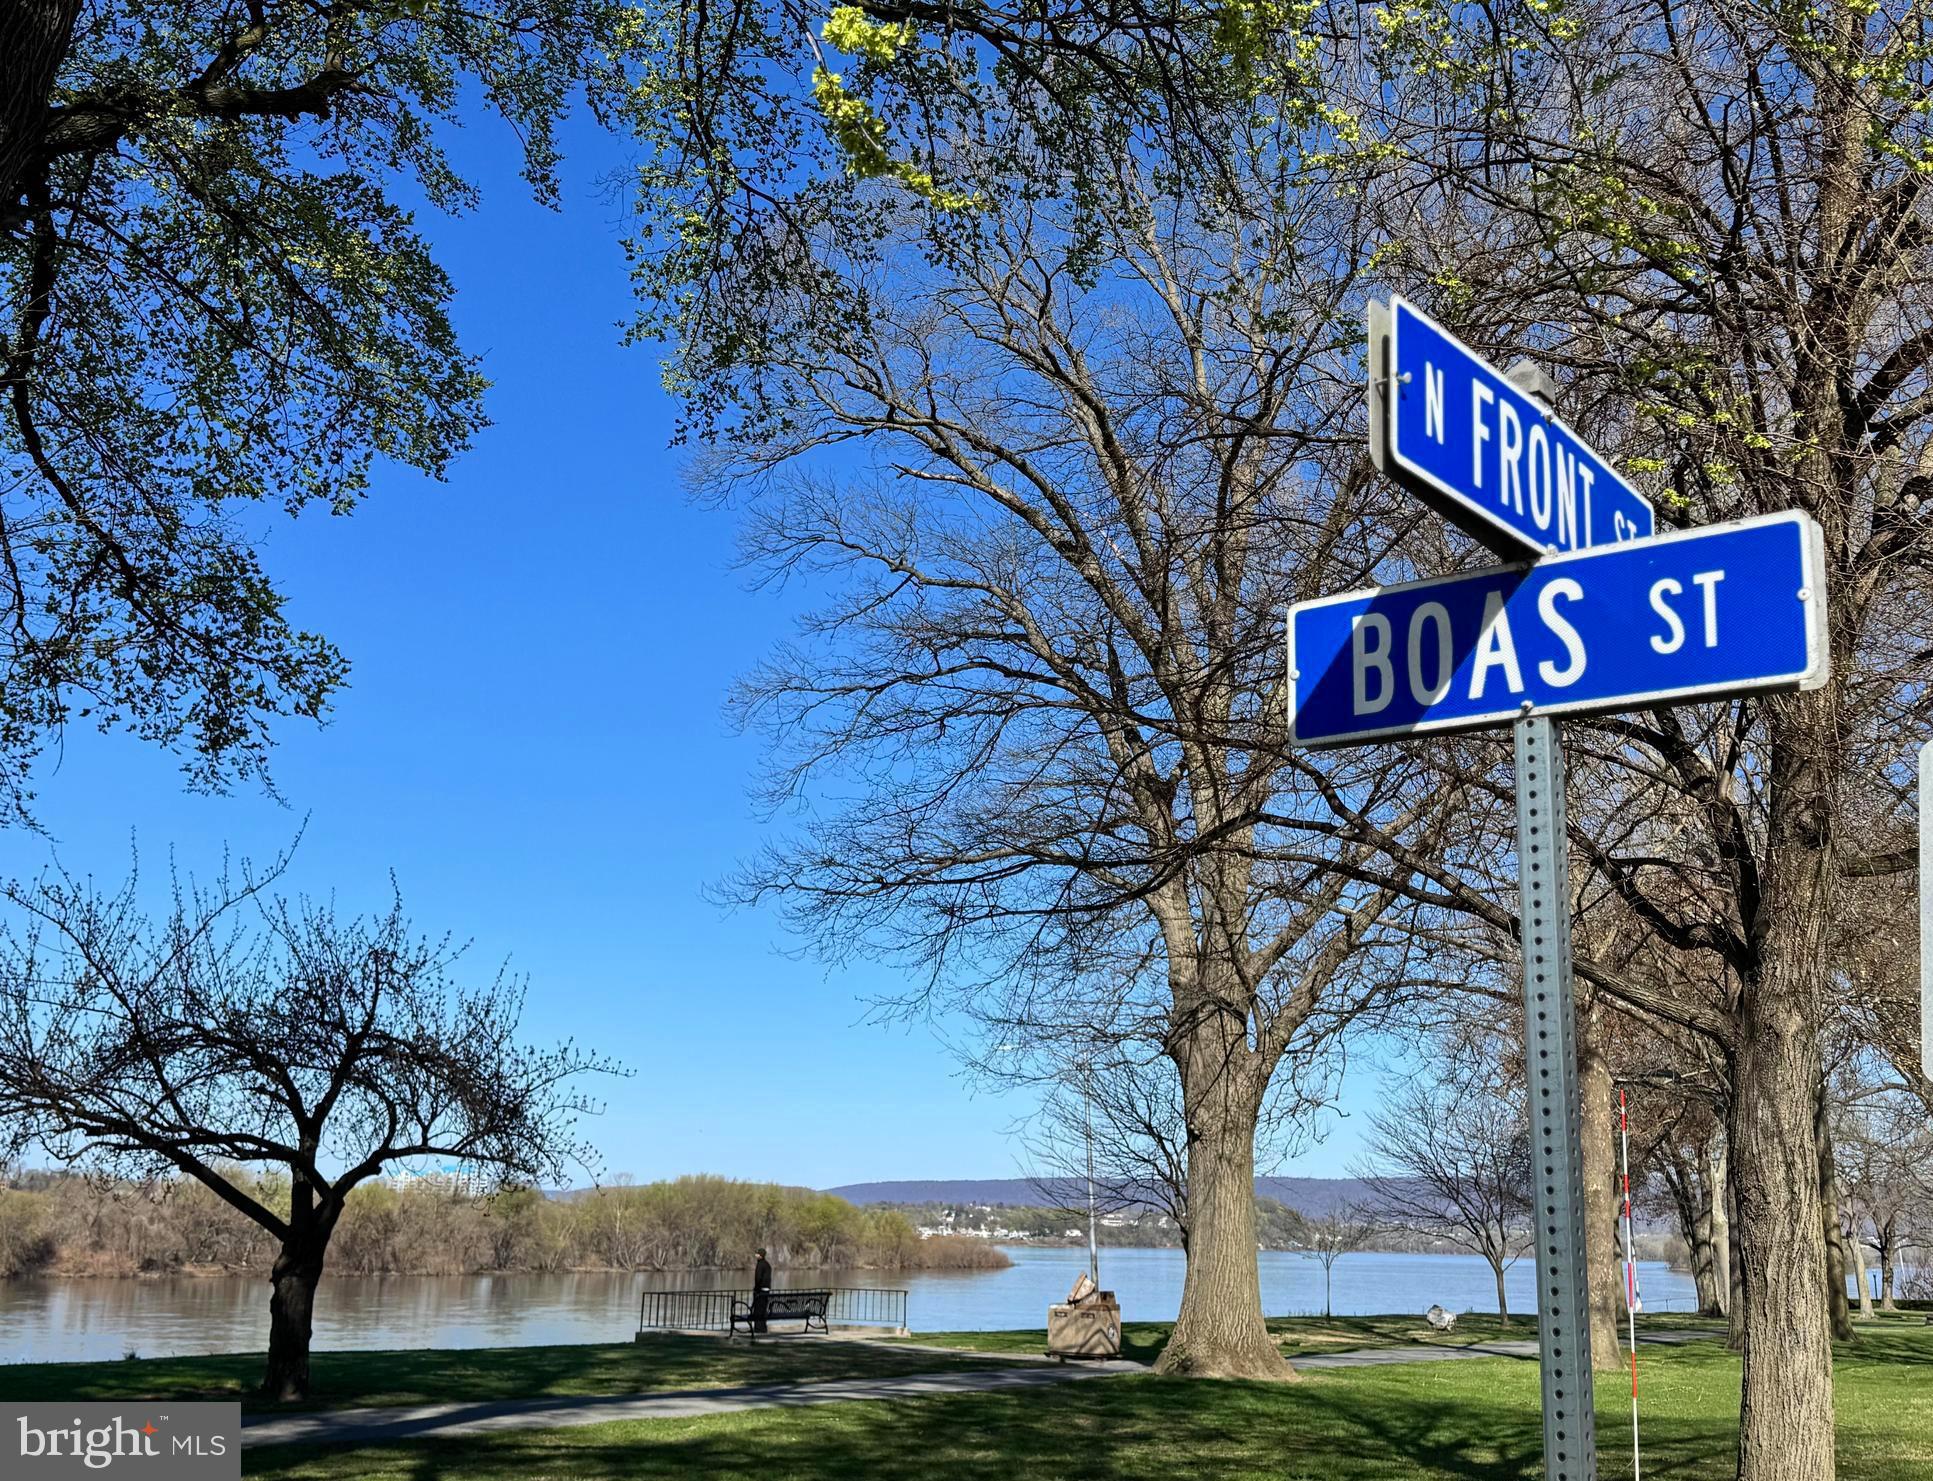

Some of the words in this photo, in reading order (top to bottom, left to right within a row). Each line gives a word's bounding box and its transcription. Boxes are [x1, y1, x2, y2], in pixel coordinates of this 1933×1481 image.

[1425, 361, 1444, 445] N
[1472, 377, 1595, 550] FRONT
[1351, 578, 1588, 716] BOAS
[1649, 570, 1726, 655] ST
